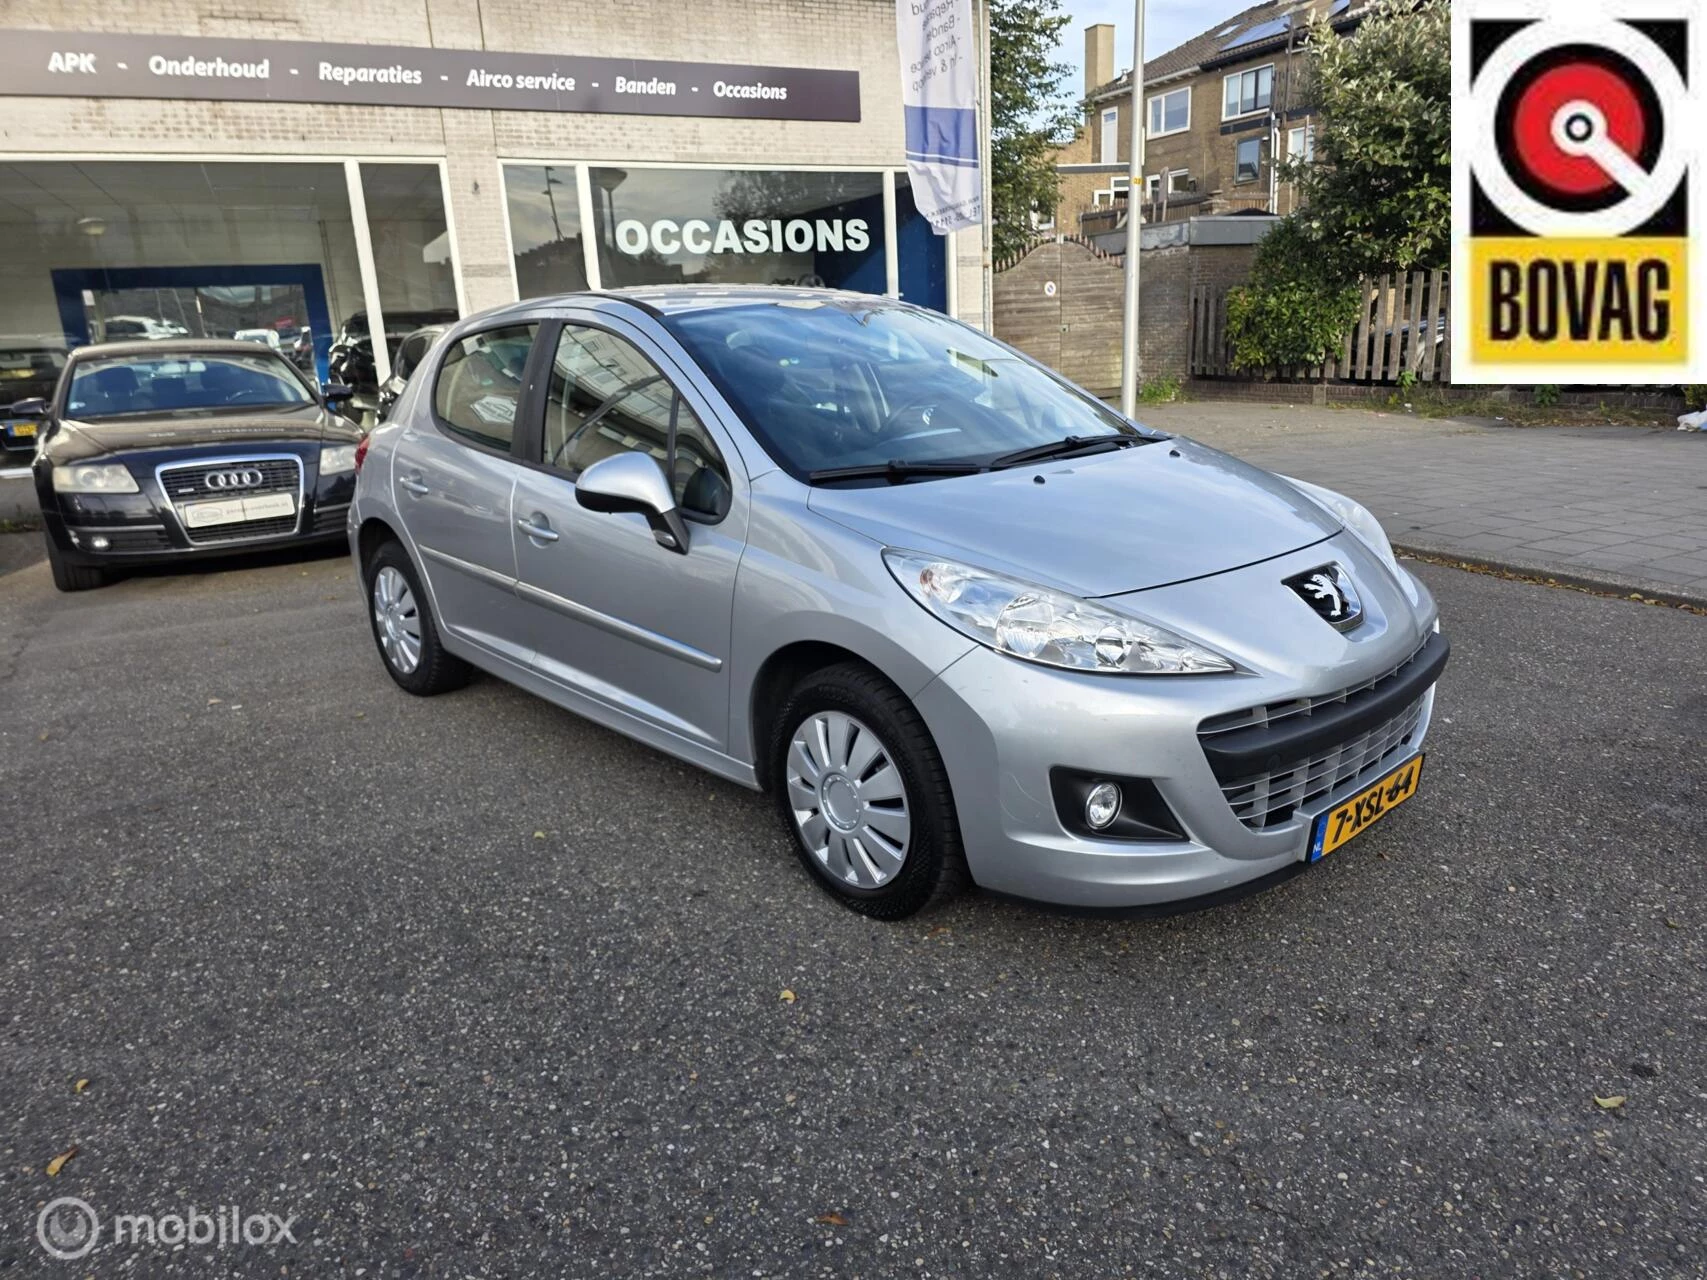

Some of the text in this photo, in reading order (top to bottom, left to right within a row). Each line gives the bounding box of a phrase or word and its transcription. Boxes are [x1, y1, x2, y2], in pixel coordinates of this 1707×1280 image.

[48, 52, 97, 74] APK
[148, 55, 270, 79] Onderhoud
[318, 62, 422, 86] Reparaties
[466, 69, 513, 88] Airco
[515, 73, 576, 91] service
[615, 76, 677, 95] Banden
[713, 81, 788, 100] Occasions
[615, 218, 870, 256] OCCASIONS
[1332, 765, 1415, 844] 7-XSL-64
